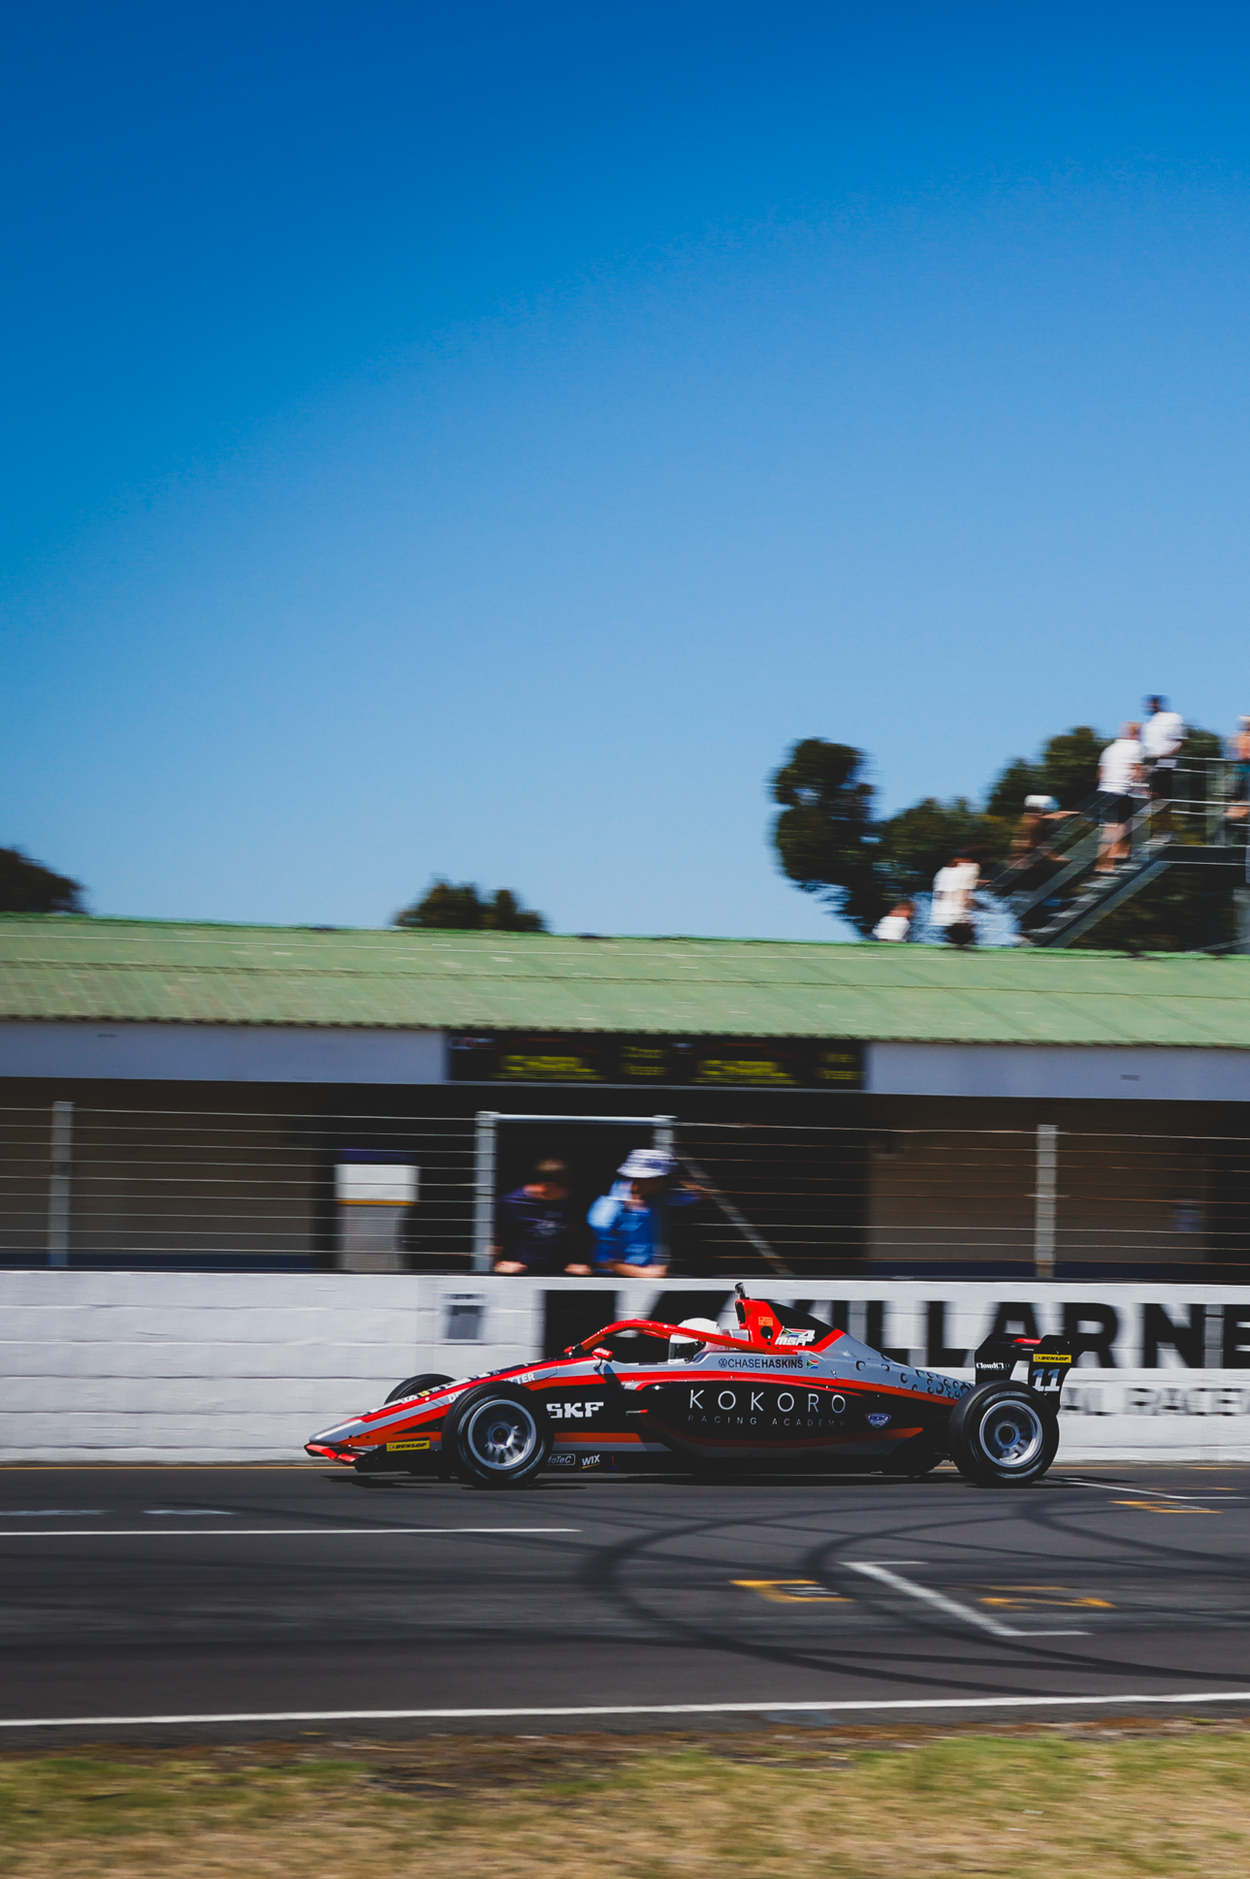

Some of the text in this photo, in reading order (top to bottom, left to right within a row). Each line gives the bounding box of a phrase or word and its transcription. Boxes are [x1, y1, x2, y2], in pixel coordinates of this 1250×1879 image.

[1031, 1368, 1061, 1392] 11
[689, 1389, 847, 1414] KOKORO
[546, 1401, 605, 1419] SKF
[687, 1414, 846, 1427] RACING ACADEMY
[395, 1442, 428, 1450] DUNLOP
[581, 1454, 600, 1466] WIX
